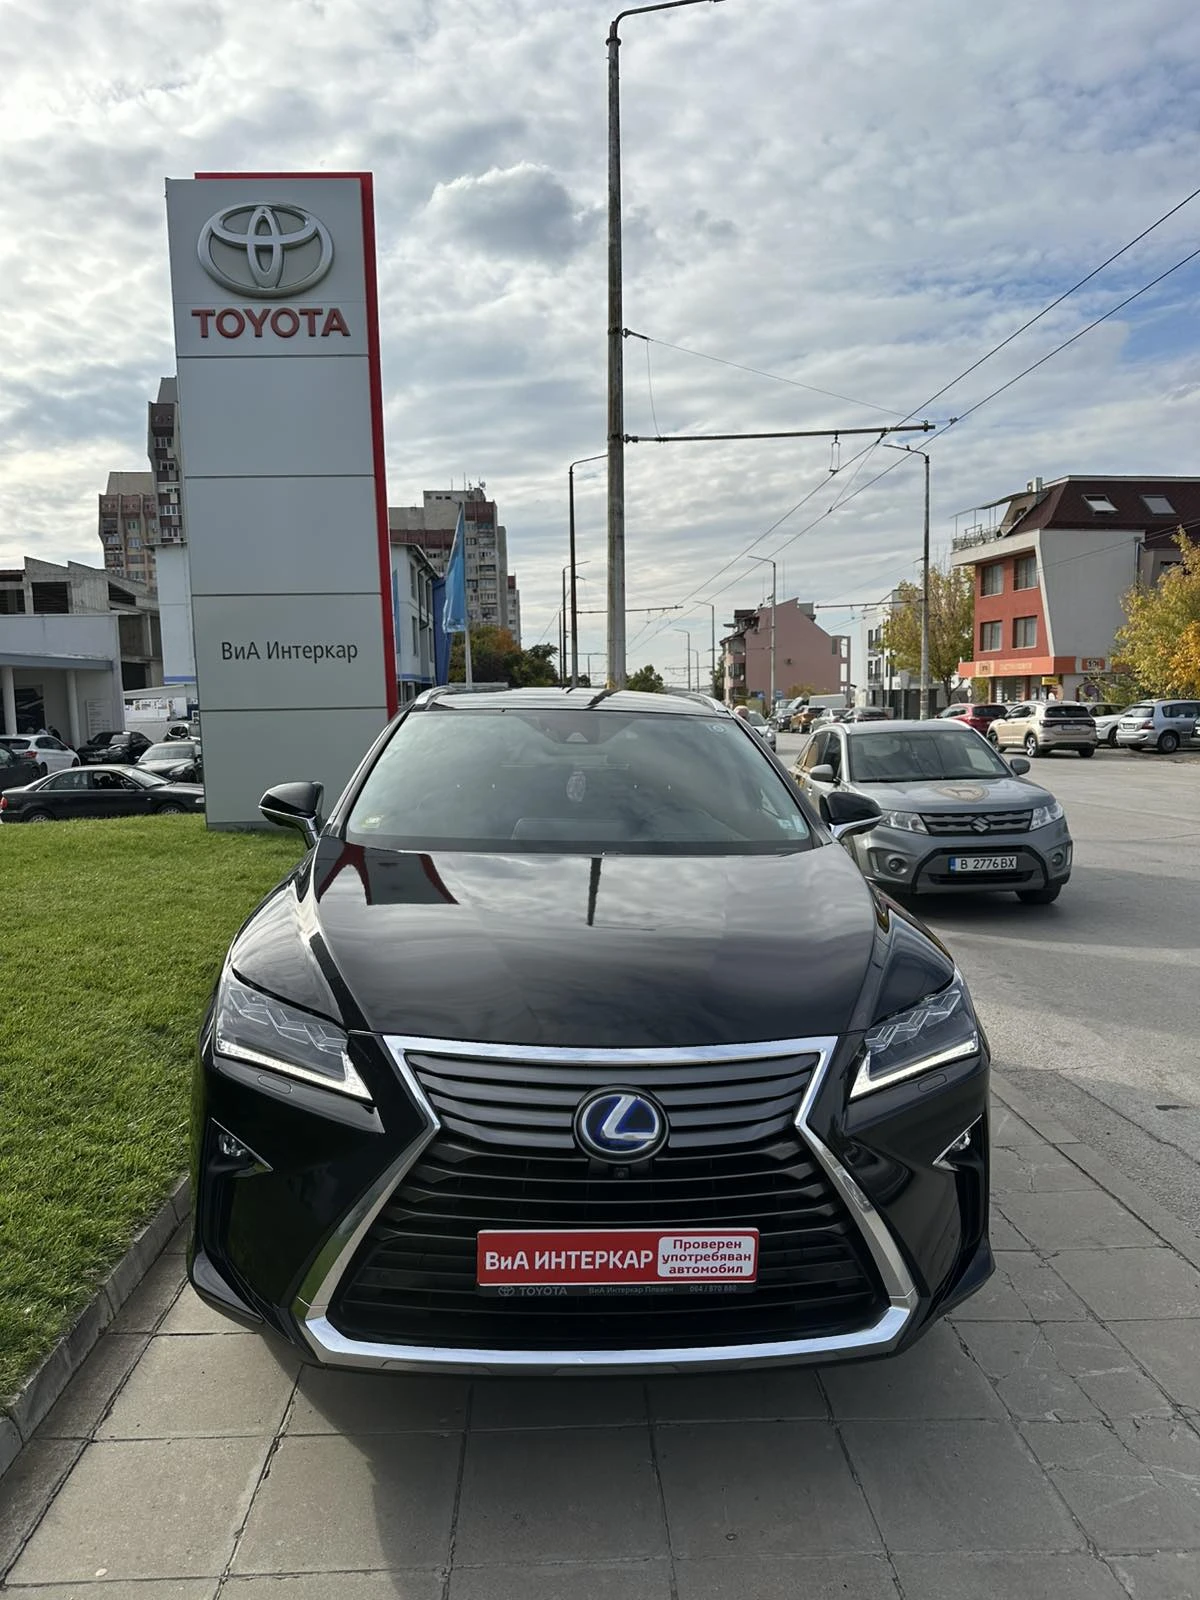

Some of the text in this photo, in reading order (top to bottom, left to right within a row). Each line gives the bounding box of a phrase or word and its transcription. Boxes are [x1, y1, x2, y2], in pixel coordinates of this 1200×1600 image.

[191, 307, 351, 338] TOYOTA
[221, 641, 358, 664] ВиА Интеркар
[960, 859, 968, 870] B
[673, 1239, 742, 1252] Проверен
[485, 1250, 653, 1270] ВиА ИНТЕРКАР
[662, 1251, 751, 1265] употребяван
[669, 1263, 743, 1274] автомобил
[520, 1286, 568, 1296] TOYOTA
